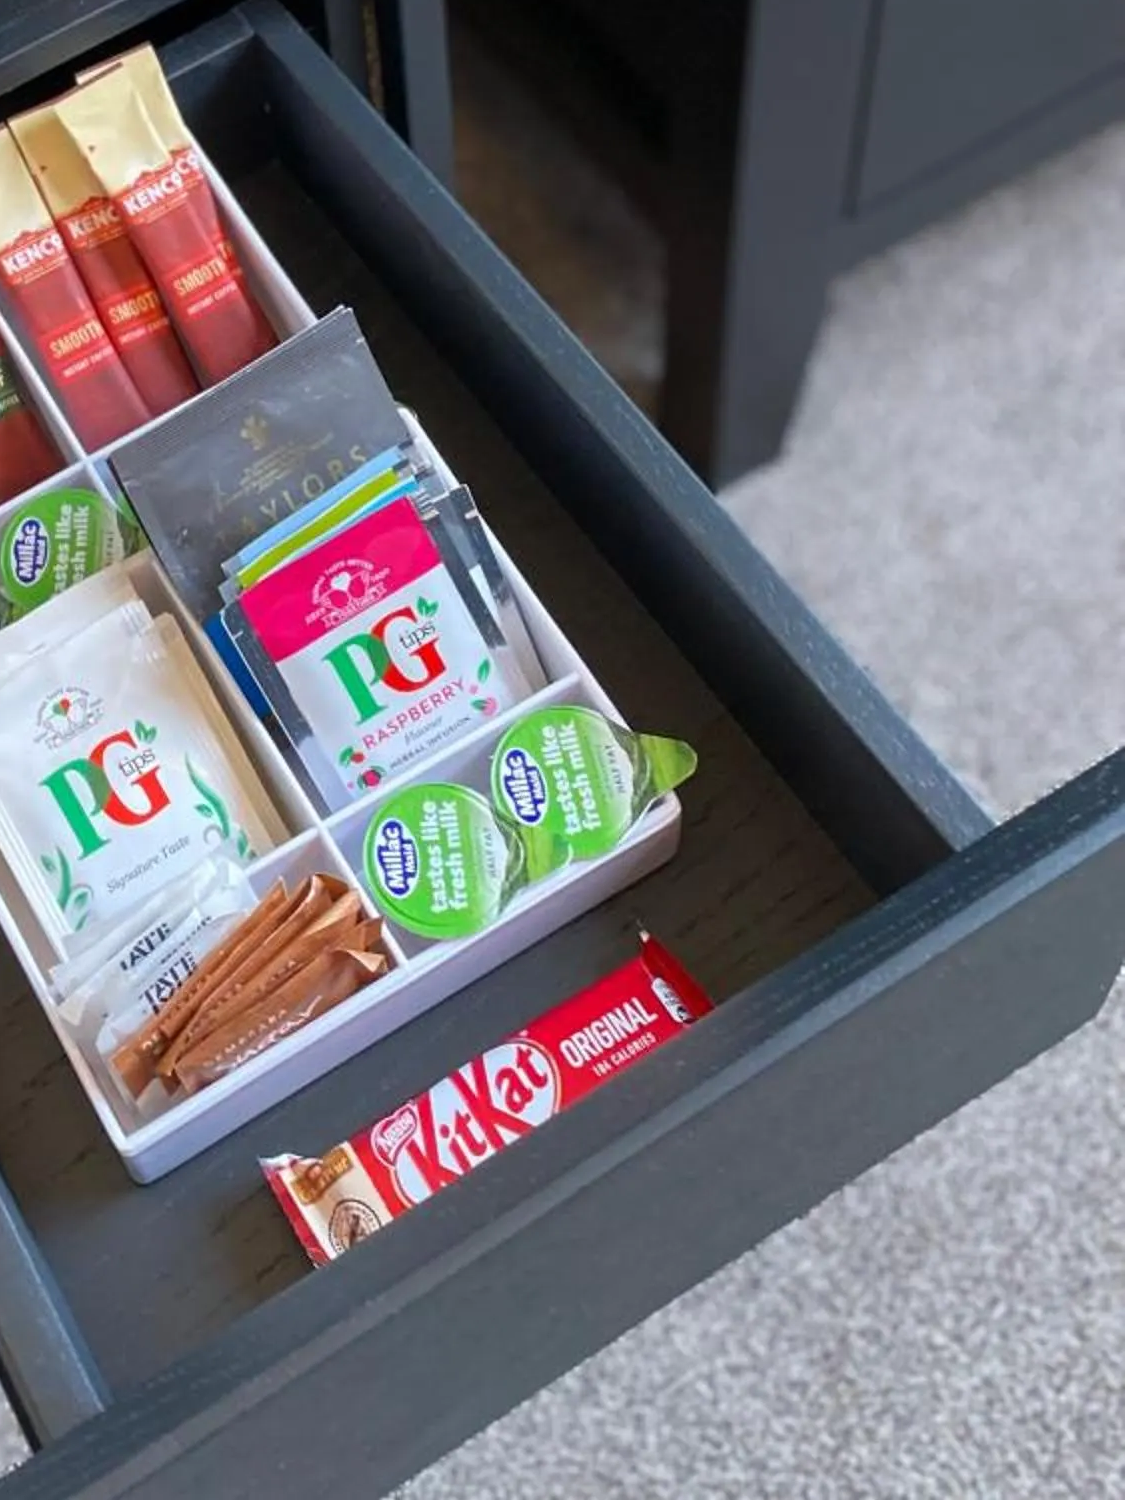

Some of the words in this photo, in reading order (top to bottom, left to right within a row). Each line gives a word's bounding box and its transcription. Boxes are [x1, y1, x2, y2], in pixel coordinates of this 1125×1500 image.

[123, 174, 183, 217] KENCO
[68, 205, 119, 239] KENC
[2, 232, 64, 276] KENCO
[108, 292, 159, 324] SMOOT
[55, 503, 73, 539] like
[73, 505, 89, 547] milk
[17, 522, 38, 578] Millac
[53, 543, 71, 594] astes
[323, 605, 446, 726] PG
[398, 621, 436, 651] tips
[362, 677, 464, 749] RASPBERRY
[541, 725, 563, 766] like
[557, 718, 586, 770] milk
[39, 729, 171, 861] PG
[118, 748, 157, 778] tips
[507, 755, 536, 816] Millac
[553, 768, 582, 836] tastes
[572, 773, 602, 831] fresh
[420, 801, 440, 841] like
[438, 801, 462, 848] milk
[161, 835, 191, 860] Taste
[381, 827, 405, 889] Millac
[427, 844, 448, 913] tastes
[445, 852, 469, 910] fresh
[559, 996, 658, 1068] ORIGINAL
[611, 1031, 657, 1066] CALORIES
[405, 1045, 548, 1194] KitKat
